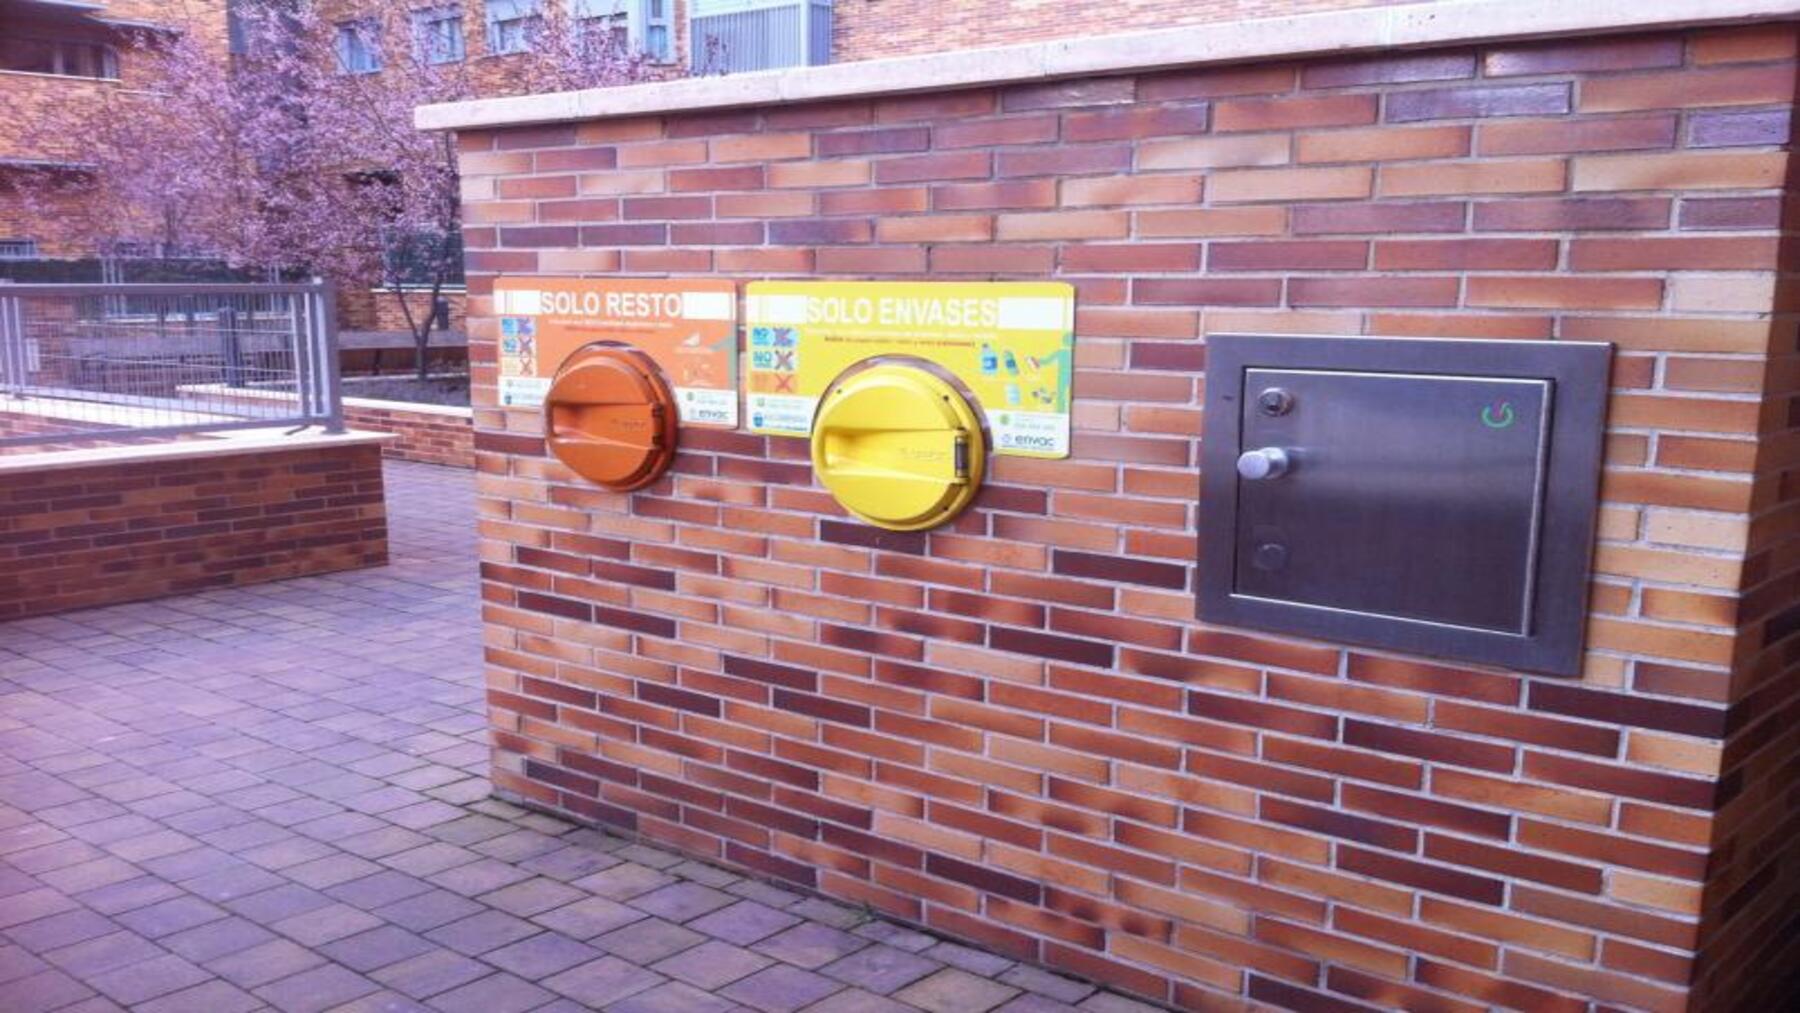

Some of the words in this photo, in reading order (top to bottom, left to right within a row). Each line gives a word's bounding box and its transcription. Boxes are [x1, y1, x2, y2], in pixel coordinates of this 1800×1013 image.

[540, 291, 600, 315] SOLO
[606, 292, 682, 318] RESTO
[806, 297, 872, 325] SOLO
[879, 298, 998, 328] ENVASES
[753, 351, 772, 363] NO
[1015, 434, 1055, 447] envac
